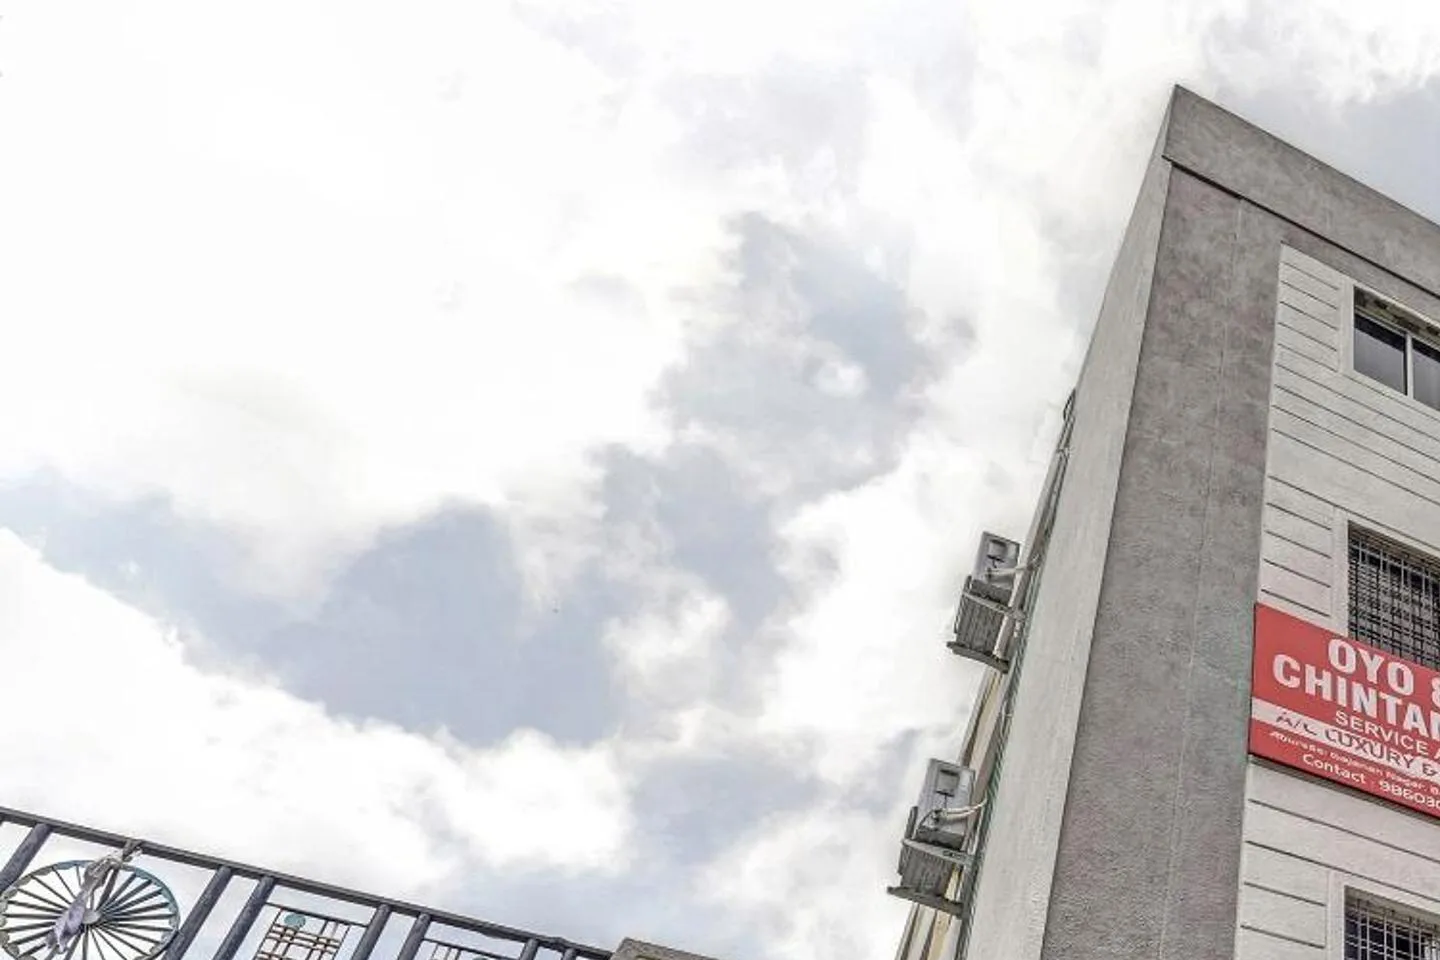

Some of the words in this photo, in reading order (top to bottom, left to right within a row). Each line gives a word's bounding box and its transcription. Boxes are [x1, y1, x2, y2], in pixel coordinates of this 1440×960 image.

[1328, 636, 1414, 699] OYO
[1324, 726, 1415, 769] LUXURY
[1422, 761, 1437, 779] &
[1335, 709, 1427, 755] SERVICE
[1302, 751, 1366, 783] Contact
